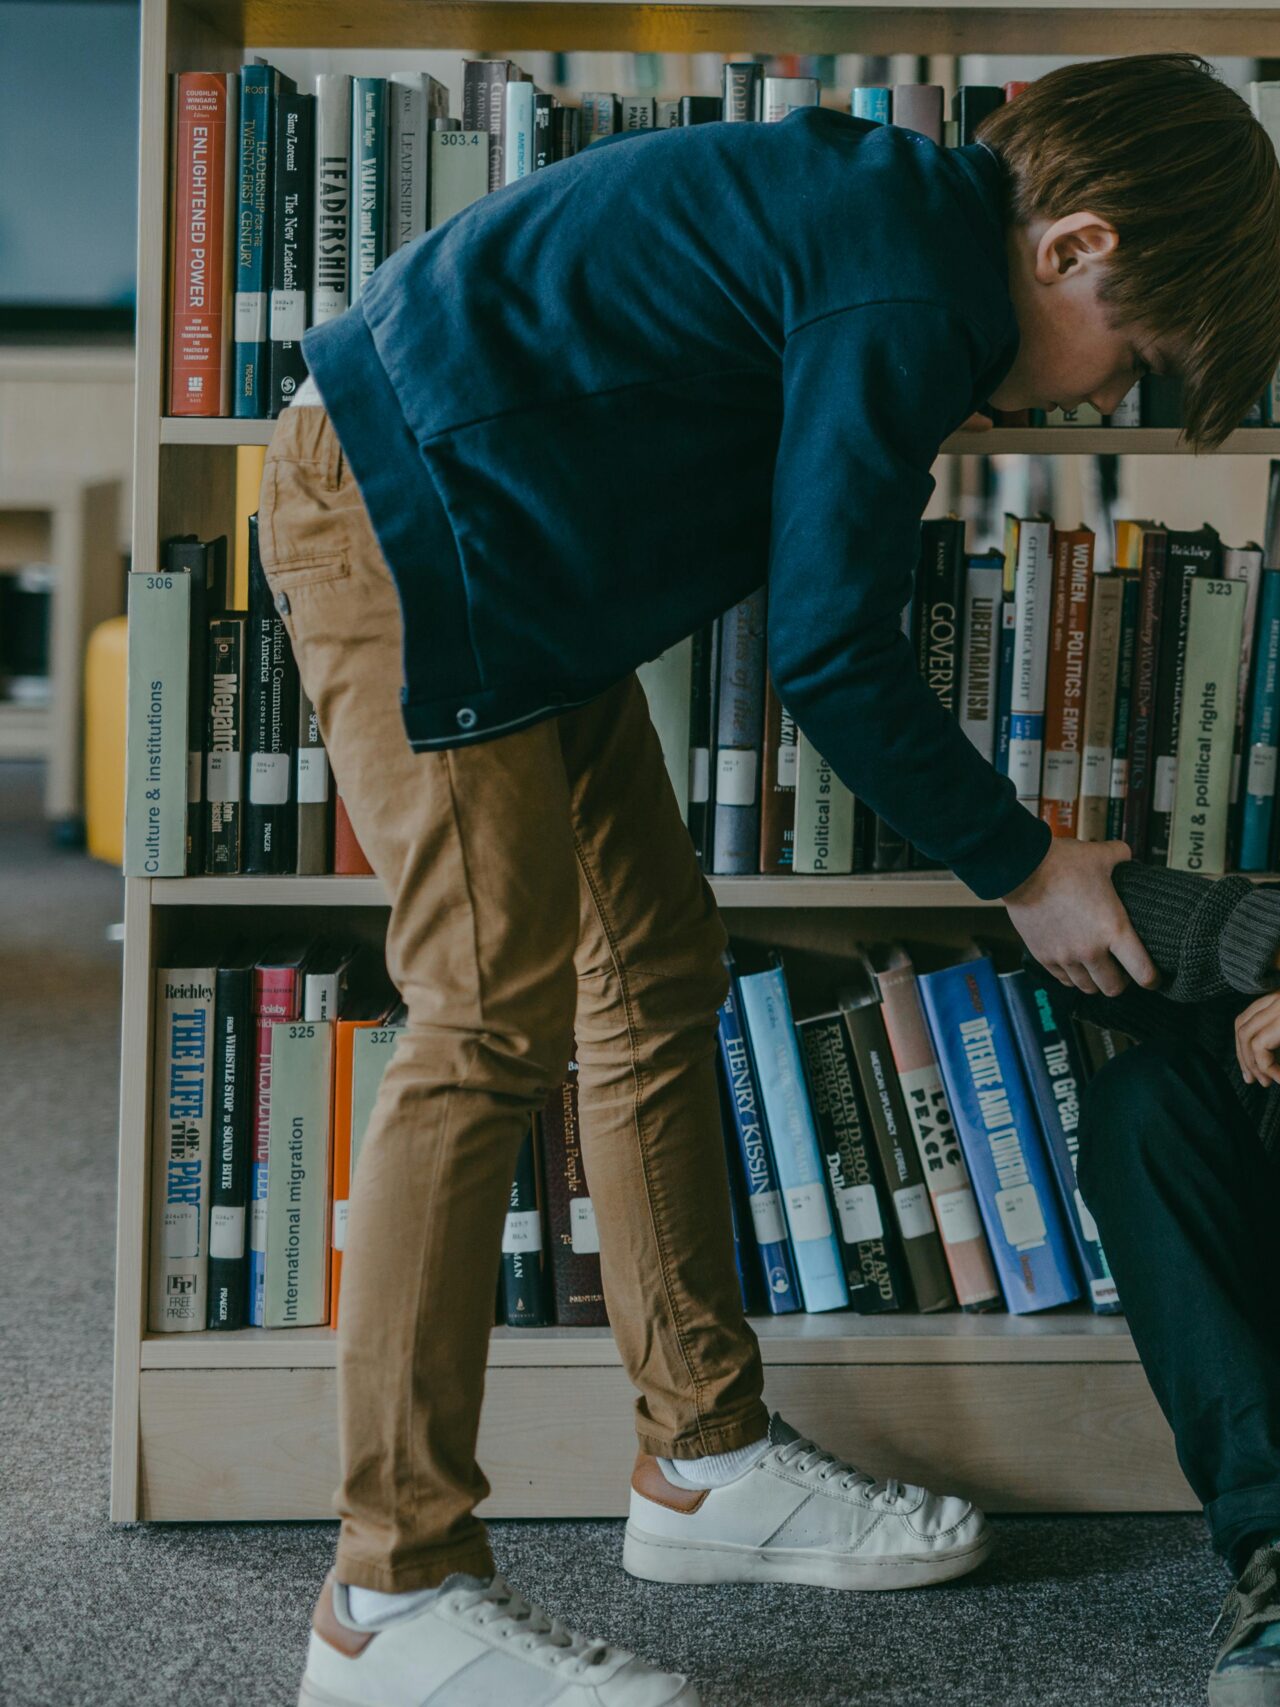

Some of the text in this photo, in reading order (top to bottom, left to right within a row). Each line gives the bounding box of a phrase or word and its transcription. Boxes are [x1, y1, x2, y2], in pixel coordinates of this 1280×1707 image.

[244, 85, 269, 96] ROST
[476, 81, 488, 128] READING
[490, 82, 504, 135] CULTURE
[400, 89, 415, 239] YUKL LEADERSHIP IN
[441, 134, 479, 146] 303.4
[240, 119, 254, 268] TWENTY-FIRST CENTURY
[254, 141, 266, 246] LEADERSHIP FOR THE
[283, 112, 298, 241] Sims/Lorenzi The New
[360, 157, 376, 236] VALUES and
[189, 126, 208, 308] ENLIGHTENED POWER
[318, 157, 347, 293] LEADERSHIP
[244, 364, 253, 396] PRAEGER
[935, 541, 944, 577] RANNEY
[146, 577, 173, 590] 306
[1207, 582, 1232, 596] 323
[260, 619, 272, 632] in
[271, 619, 285, 664] Political
[1019, 536, 1038, 701] GETTING AMERICA RIGHT
[1063, 543, 1088, 698] WOMEN POLITICS
[260, 635, 273, 683] America
[966, 598, 993, 722] LIBERTARIANISM
[1095, 606, 1116, 717] NATIONAL
[308, 714, 317, 742] SPICER
[1131, 646, 1159, 790] WOMEN POLITICS
[145, 681, 163, 873] Culture & institutions
[1188, 683, 1218, 870] Civil & political rights
[263, 823, 271, 852] PRAEGER
[814, 799, 830, 870] Political
[165, 984, 215, 1003] Reichley
[261, 1004, 286, 1015] Polsby
[289, 1025, 315, 1039] 325
[370, 1031, 396, 1044] 327
[169, 1009, 205, 1119] THE LIFE
[224, 1034, 237, 1082] WHISTLE
[725, 1037, 757, 1114] HENRY
[815, 1028, 843, 1125] AMERICAN
[223, 1084, 235, 1111] STOP
[979, 1089, 1012, 1129] AND
[1042, 1040, 1079, 1132] The Great
[171, 1121, 186, 1159] THE
[186, 1128, 200, 1150] OF
[561, 1080, 580, 1192] American People
[869, 1050, 908, 1182] AMERICAN DIPLOMACY FERRELL
[910, 1089, 942, 1172] PEACE
[221, 1125, 234, 1161] SOUND
[829, 1023, 894, 1300] FRANKLIN AND
[220, 1163, 232, 1189] BITE
[283, 1117, 305, 1321] International migration
[166, 1308, 195, 1319] PRESS
[169, 1297, 191, 1308] FREE
[219, 1287, 227, 1321] PRAEGER
